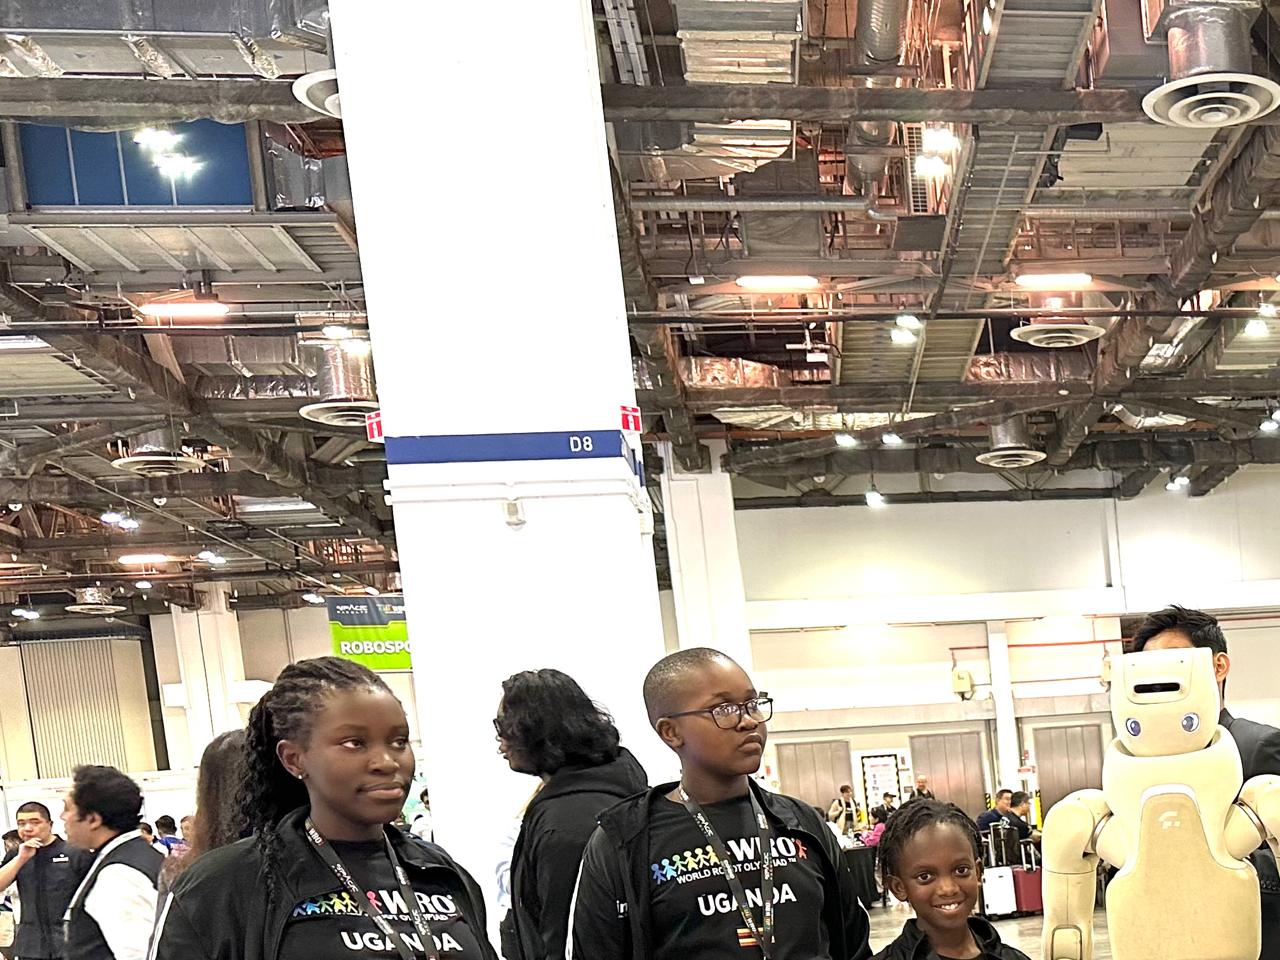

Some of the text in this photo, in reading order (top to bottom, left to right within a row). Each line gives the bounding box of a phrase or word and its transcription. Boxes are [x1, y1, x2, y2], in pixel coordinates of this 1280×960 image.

[569, 436, 594, 452] D8
[676, 869, 711, 885] WORLD
[712, 864, 742, 876] ROT
[743, 857, 788, 873] OLYIAD
